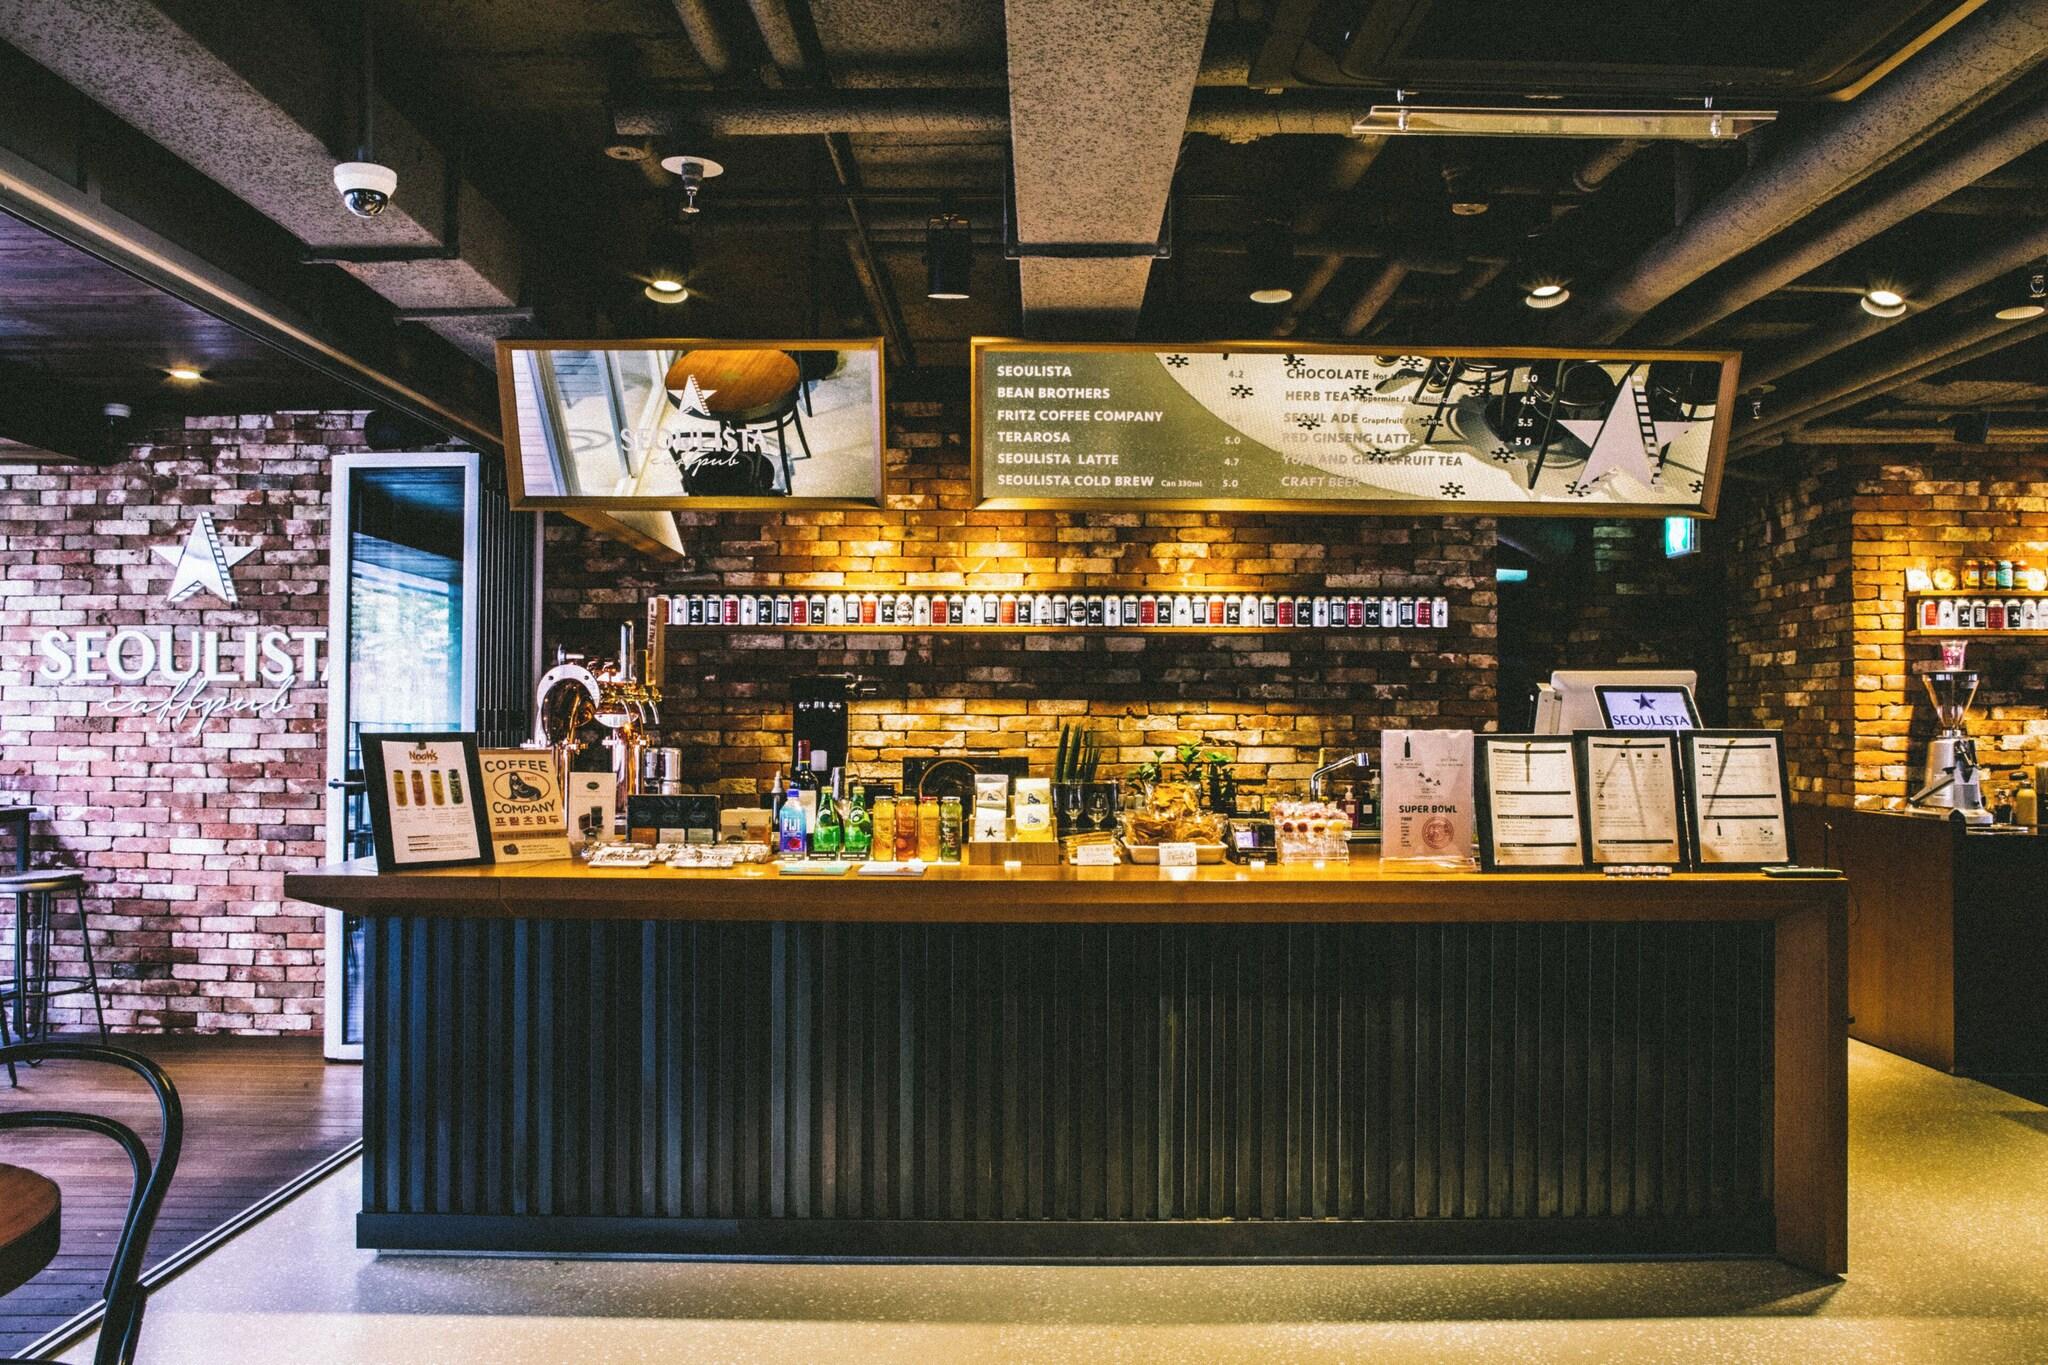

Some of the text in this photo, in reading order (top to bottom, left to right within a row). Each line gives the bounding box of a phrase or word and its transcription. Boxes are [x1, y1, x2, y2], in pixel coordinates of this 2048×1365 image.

[997, 365, 1072, 377] SEOULISTA
[1228, 370, 1244, 379] 4.2
[1286, 368, 1369, 380] CHOCOLATE
[1522, 374, 1538, 383] 5.0
[997, 387, 1111, 400] BEAN BROTHERS
[1285, 390, 1321, 402] HERB
[1324, 391, 1350, 402] TEA
[1520, 396, 1536, 405] 4.5
[997, 410, 1163, 422] FRITZ COFFEE COMPANY
[1283, 412, 1327, 424] SEOUL
[1330, 413, 1358, 424] ADE
[1361, 416, 1403, 426] Grapefruit
[1517, 418, 1533, 427] 5.5
[620, 428, 768, 452] SEOULISTA
[997, 431, 1071, 443] TERAROSA
[1224, 436, 1241, 445] 5.0
[1282, 432, 1416, 444] RED GINSENG LATTE
[1515, 437, 1531, 446] 50
[997, 453, 1119, 465] SEOULISTA LATTE
[1224, 458, 1240, 467] 4.7
[1318, 455, 1348, 465] AND
[1439, 456, 1463, 466] TEA
[997, 475, 1071, 486] SEOULISTA
[1074, 475, 1112, 487] COLD
[1114, 475, 1154, 487] BREW
[1222, 479, 1239, 488] 5.0
[1280, 476, 1361, 487] CRAFT BEER
[39, 630, 328, 682] SEOULIST
[1612, 714, 1690, 726] SEOULISTA
[484, 759, 549, 773] COFFEE
[492, 799, 556, 815] COMPANY
[1399, 805, 1458, 814] SUPER BOWL
